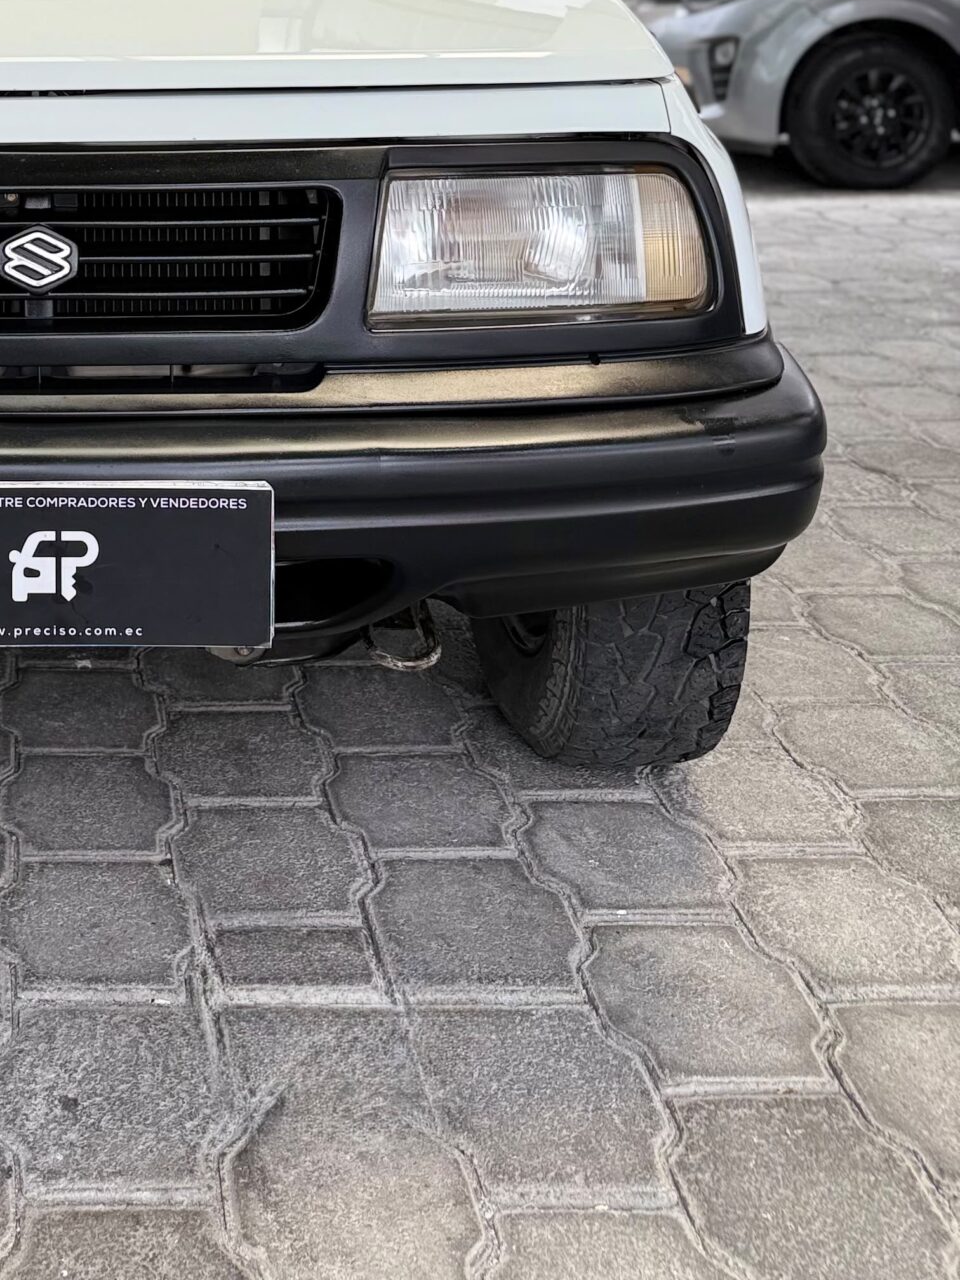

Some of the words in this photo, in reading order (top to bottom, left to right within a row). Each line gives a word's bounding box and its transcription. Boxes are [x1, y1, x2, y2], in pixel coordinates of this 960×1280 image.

[26, 496, 136, 508] COMPRADORES
[139, 497, 148, 508] Y
[149, 497, 248, 509] VENDEDORES
